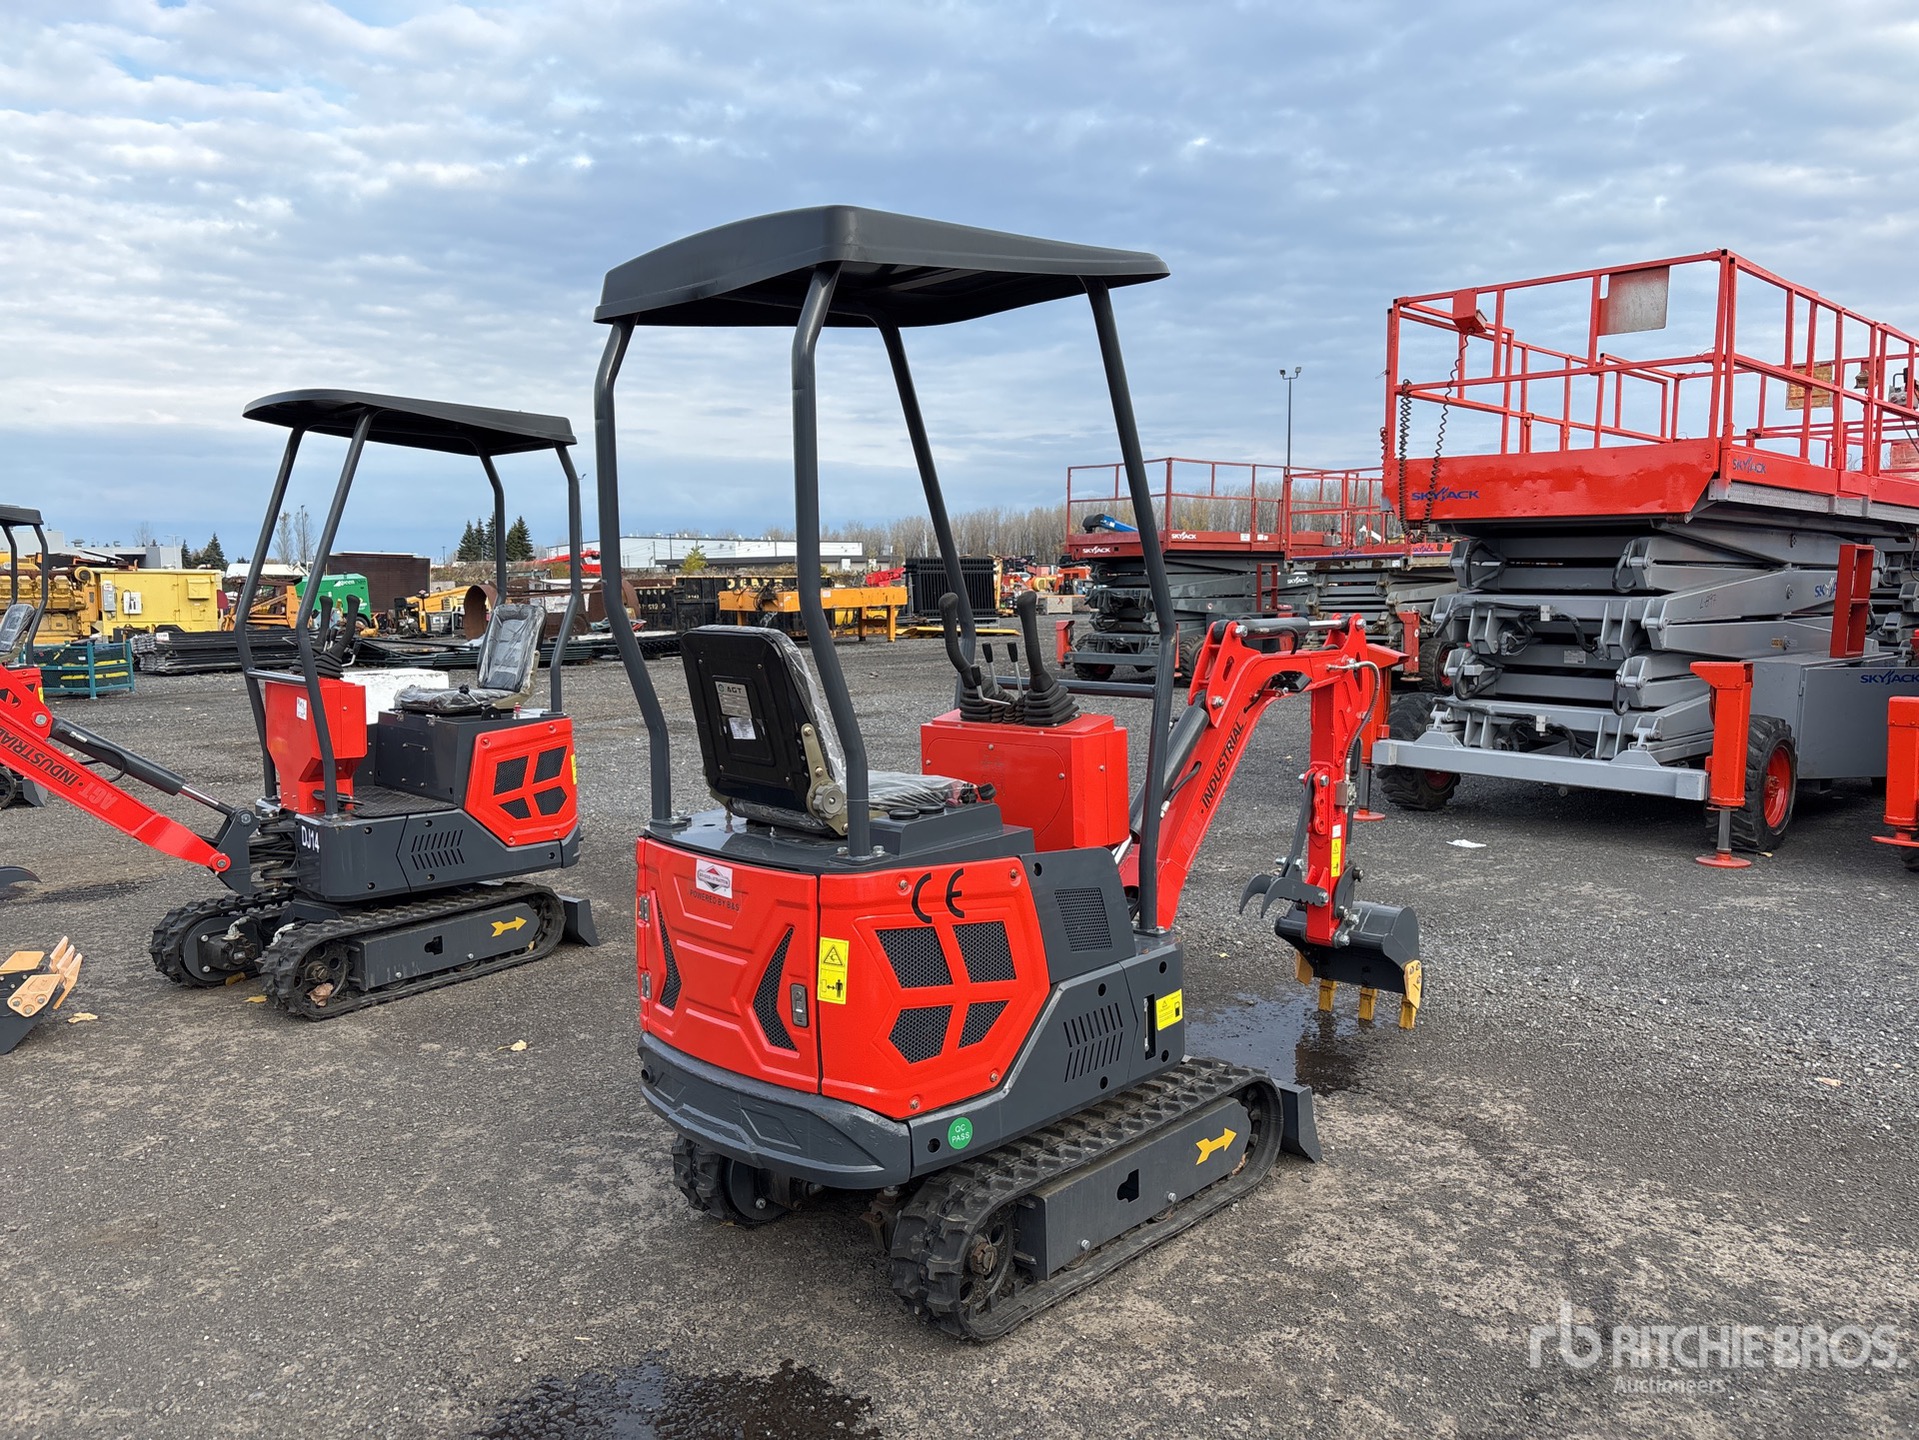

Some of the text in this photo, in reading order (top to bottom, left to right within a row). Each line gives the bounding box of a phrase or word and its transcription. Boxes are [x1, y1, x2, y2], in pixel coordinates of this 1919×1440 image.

[1733, 455, 1766, 474] SKYJACK
[1412, 487, 1479, 502] SKYJACK
[1171, 531, 1197, 540] SKYJACK
[1083, 546, 1110, 554] SKYJACK
[1287, 576, 1308, 584] SKYJACK
[1815, 577, 1838, 598] SKYJA
[727, 686, 742, 694] AGT
[1202, 721, 1244, 809] INDUSTRIAL
[78, 781, 119, 811] AGT
[301, 825, 320, 853] DJ14
[690, 890, 739, 911] POWERED BY B&S
[911, 867, 965, 924] CE
[955, 1123, 967, 1133] QC
[951, 1131, 970, 1143] PASS
